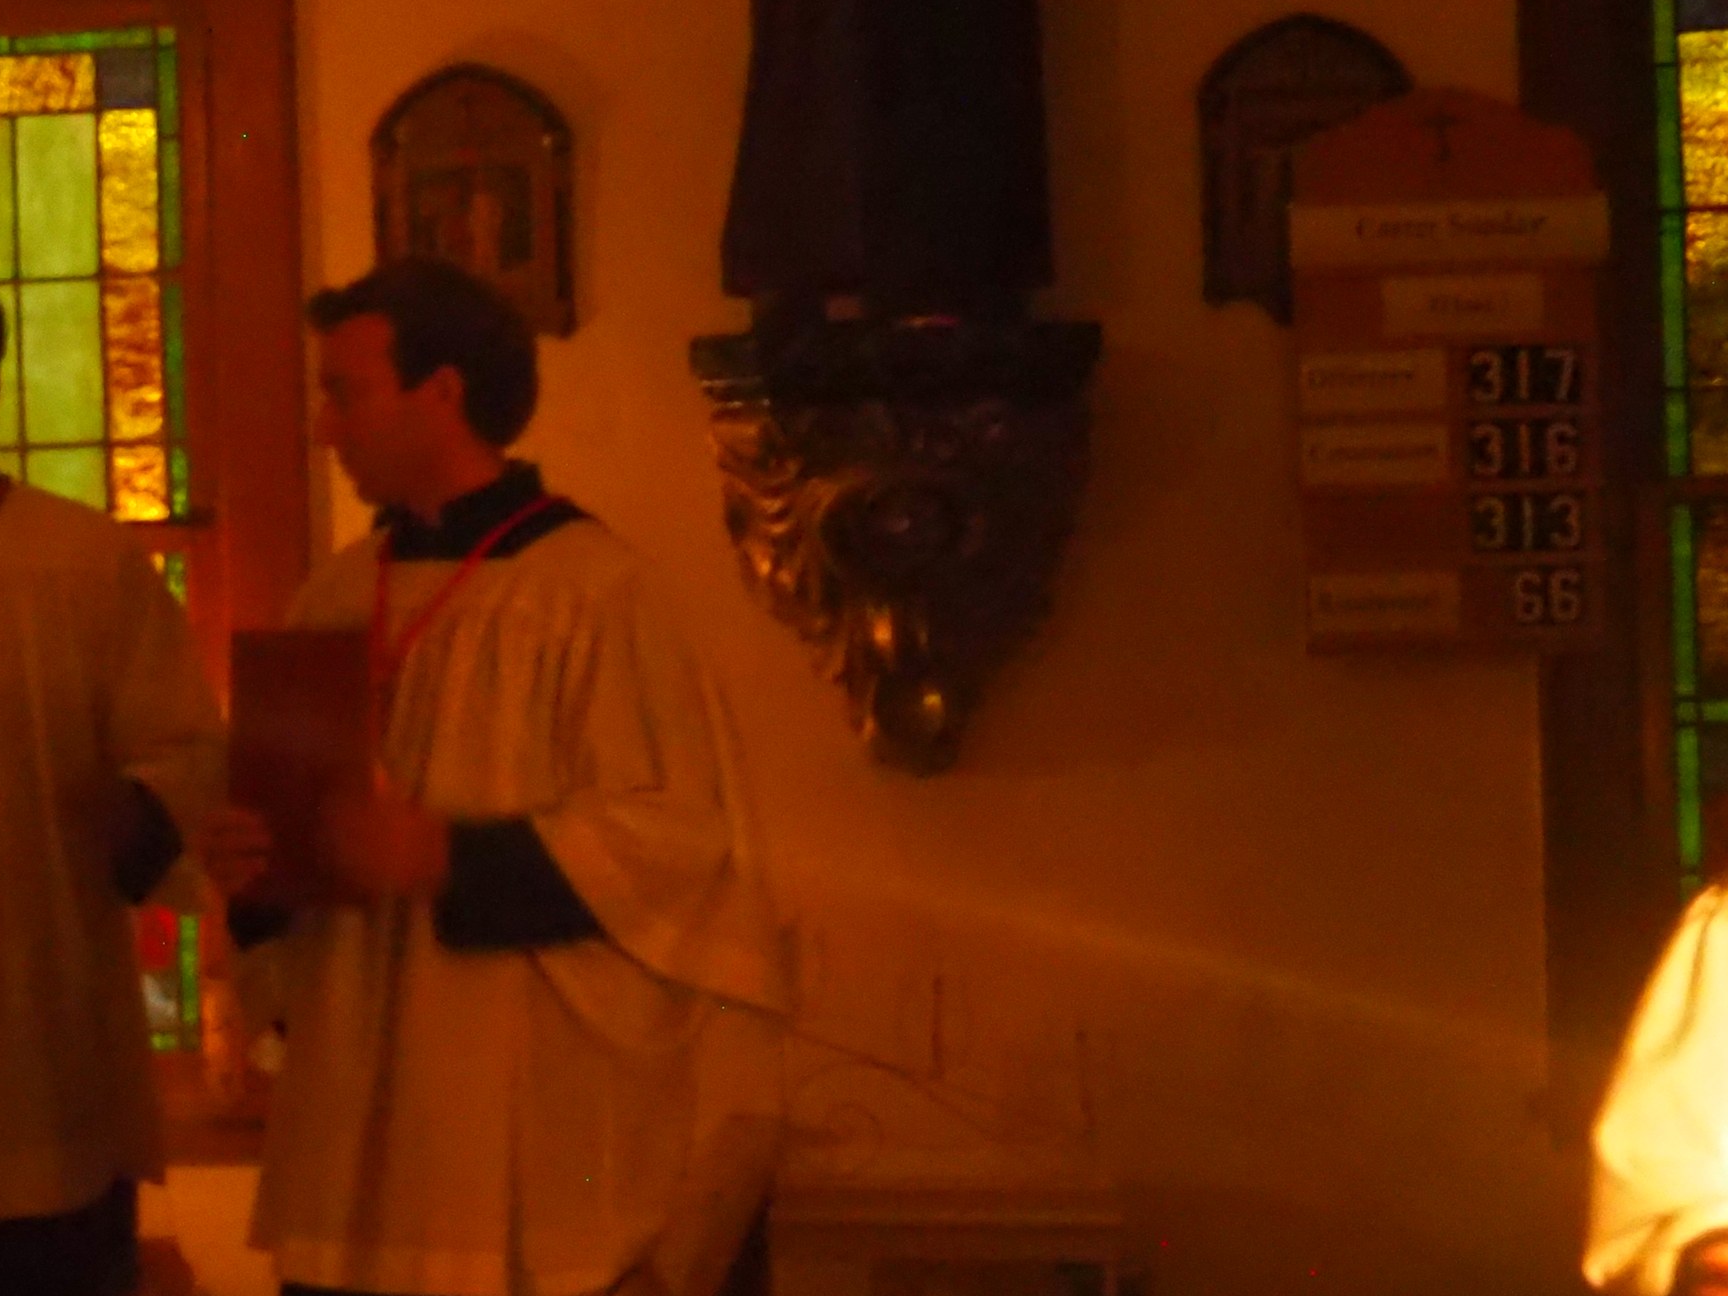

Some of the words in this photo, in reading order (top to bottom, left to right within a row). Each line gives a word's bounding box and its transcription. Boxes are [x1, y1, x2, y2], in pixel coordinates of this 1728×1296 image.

[1470, 349, 1576, 402] 317
[1471, 423, 1578, 476] 316
[1475, 495, 1581, 548] 313
[1514, 569, 1581, 623] 66
